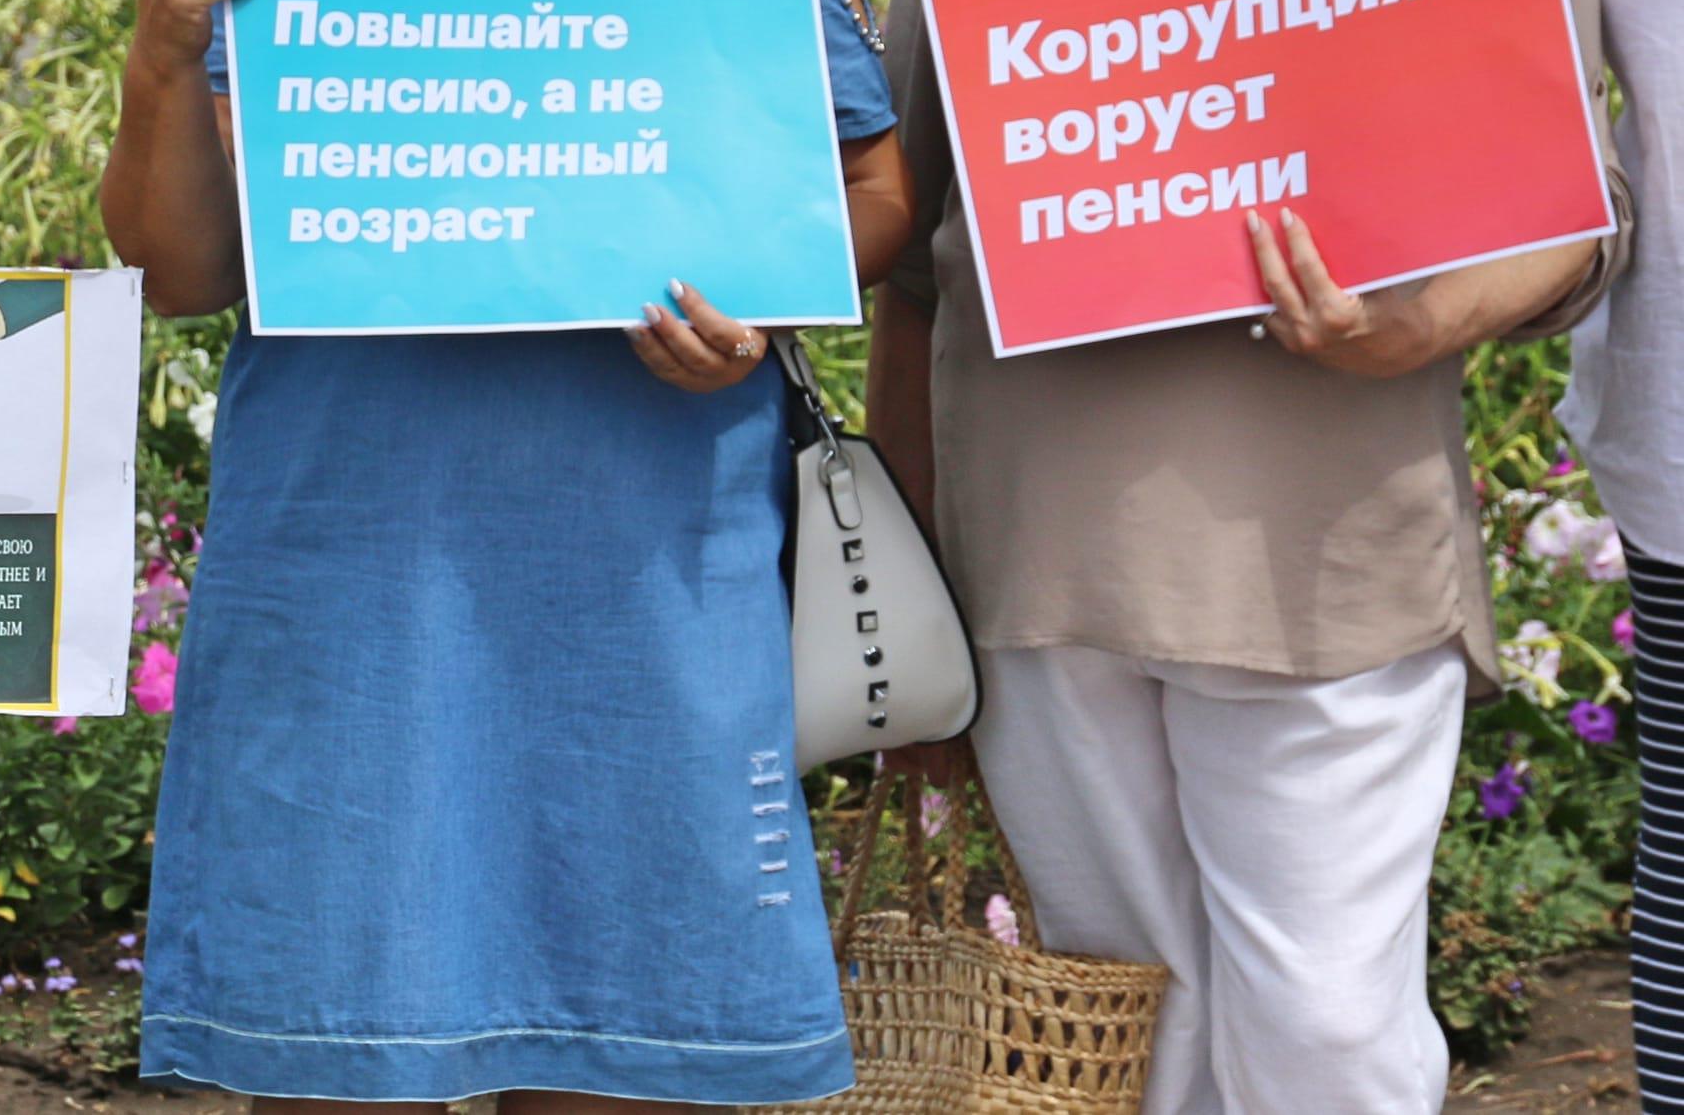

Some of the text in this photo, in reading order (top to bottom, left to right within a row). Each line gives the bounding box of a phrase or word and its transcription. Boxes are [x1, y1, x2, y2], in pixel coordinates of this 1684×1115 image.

[277, 76, 665, 119] пенсию, а не
[1003, 73, 1275, 164] ворует
[282, 127, 670, 178] пенсионный
[1020, 151, 1309, 244] пенсии
[288, 205, 536, 253] возраст
[36, 566, 46, 582] И
